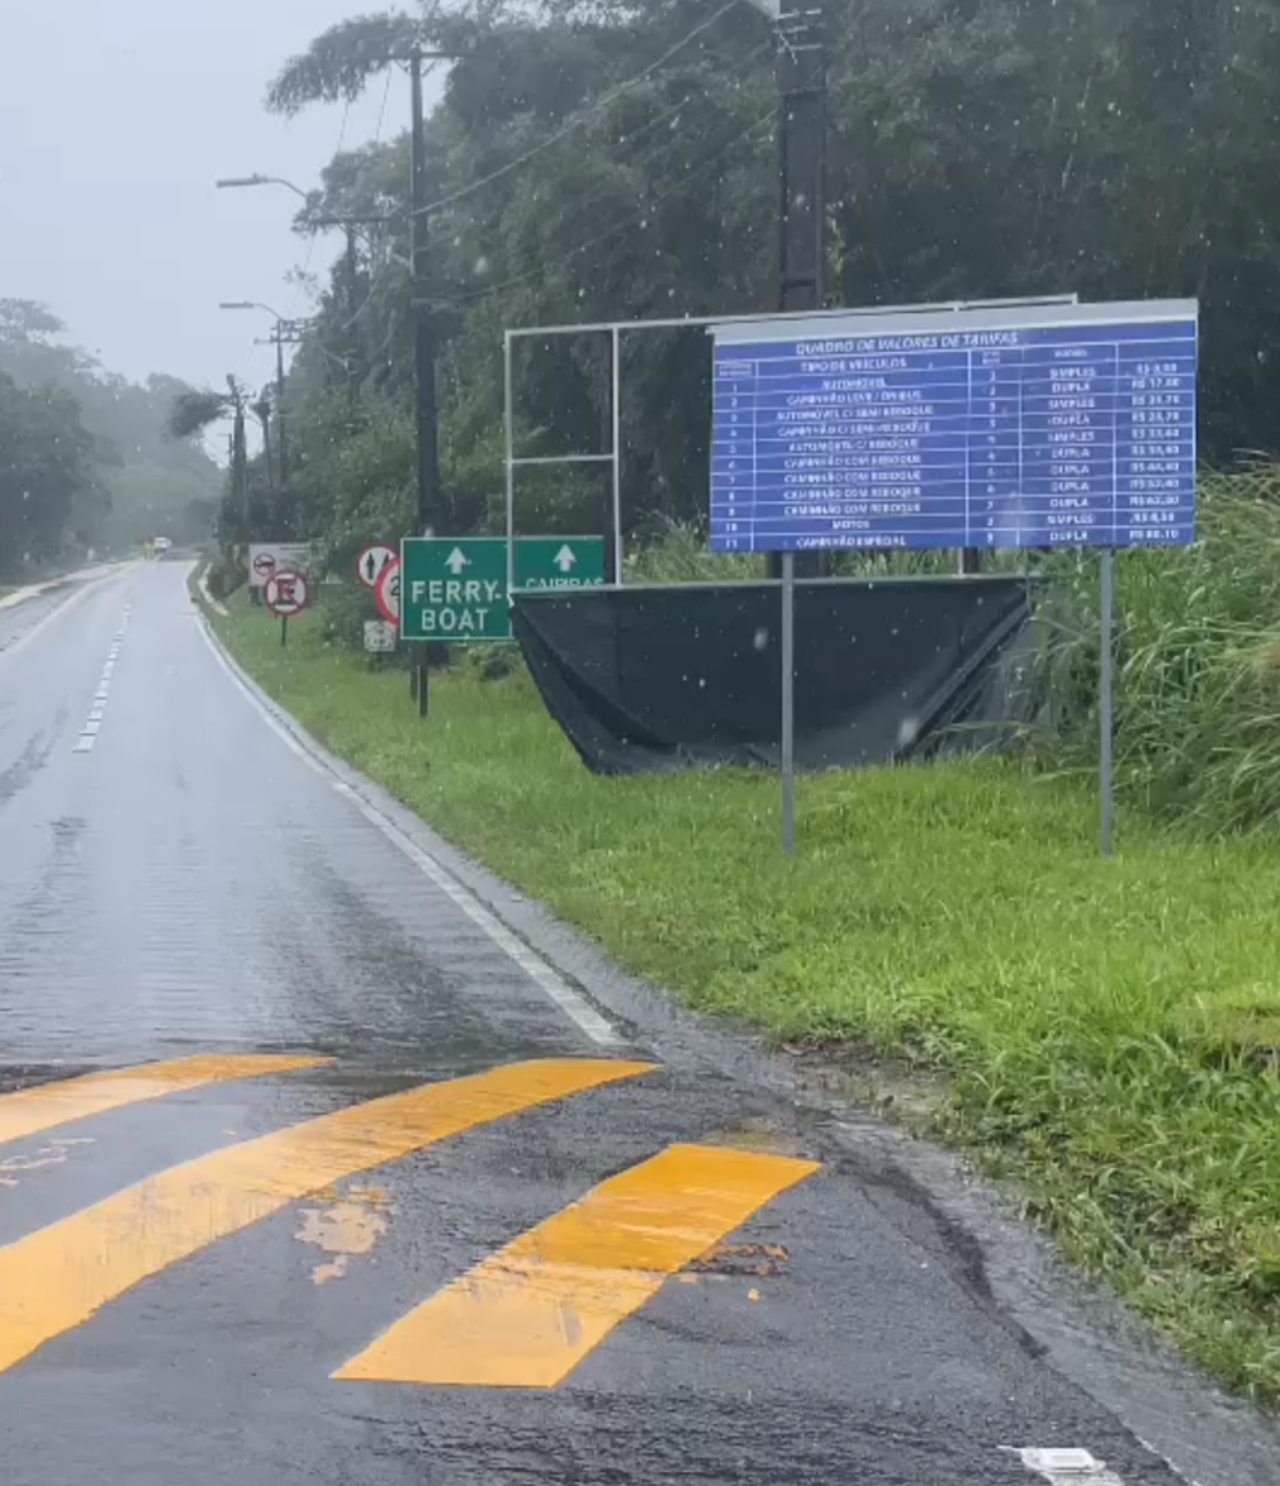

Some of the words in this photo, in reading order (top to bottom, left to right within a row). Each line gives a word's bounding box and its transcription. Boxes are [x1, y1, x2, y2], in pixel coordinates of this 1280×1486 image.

[796, 341, 852, 355] QUADRO
[857, 339, 874, 350] DE
[878, 335, 937, 350] VALORES
[940, 336, 957, 346] DE
[959, 333, 1018, 346] TARIFAS
[849, 356, 906, 369] VEÍCULOS
[420, 608, 490, 632] BOAT
